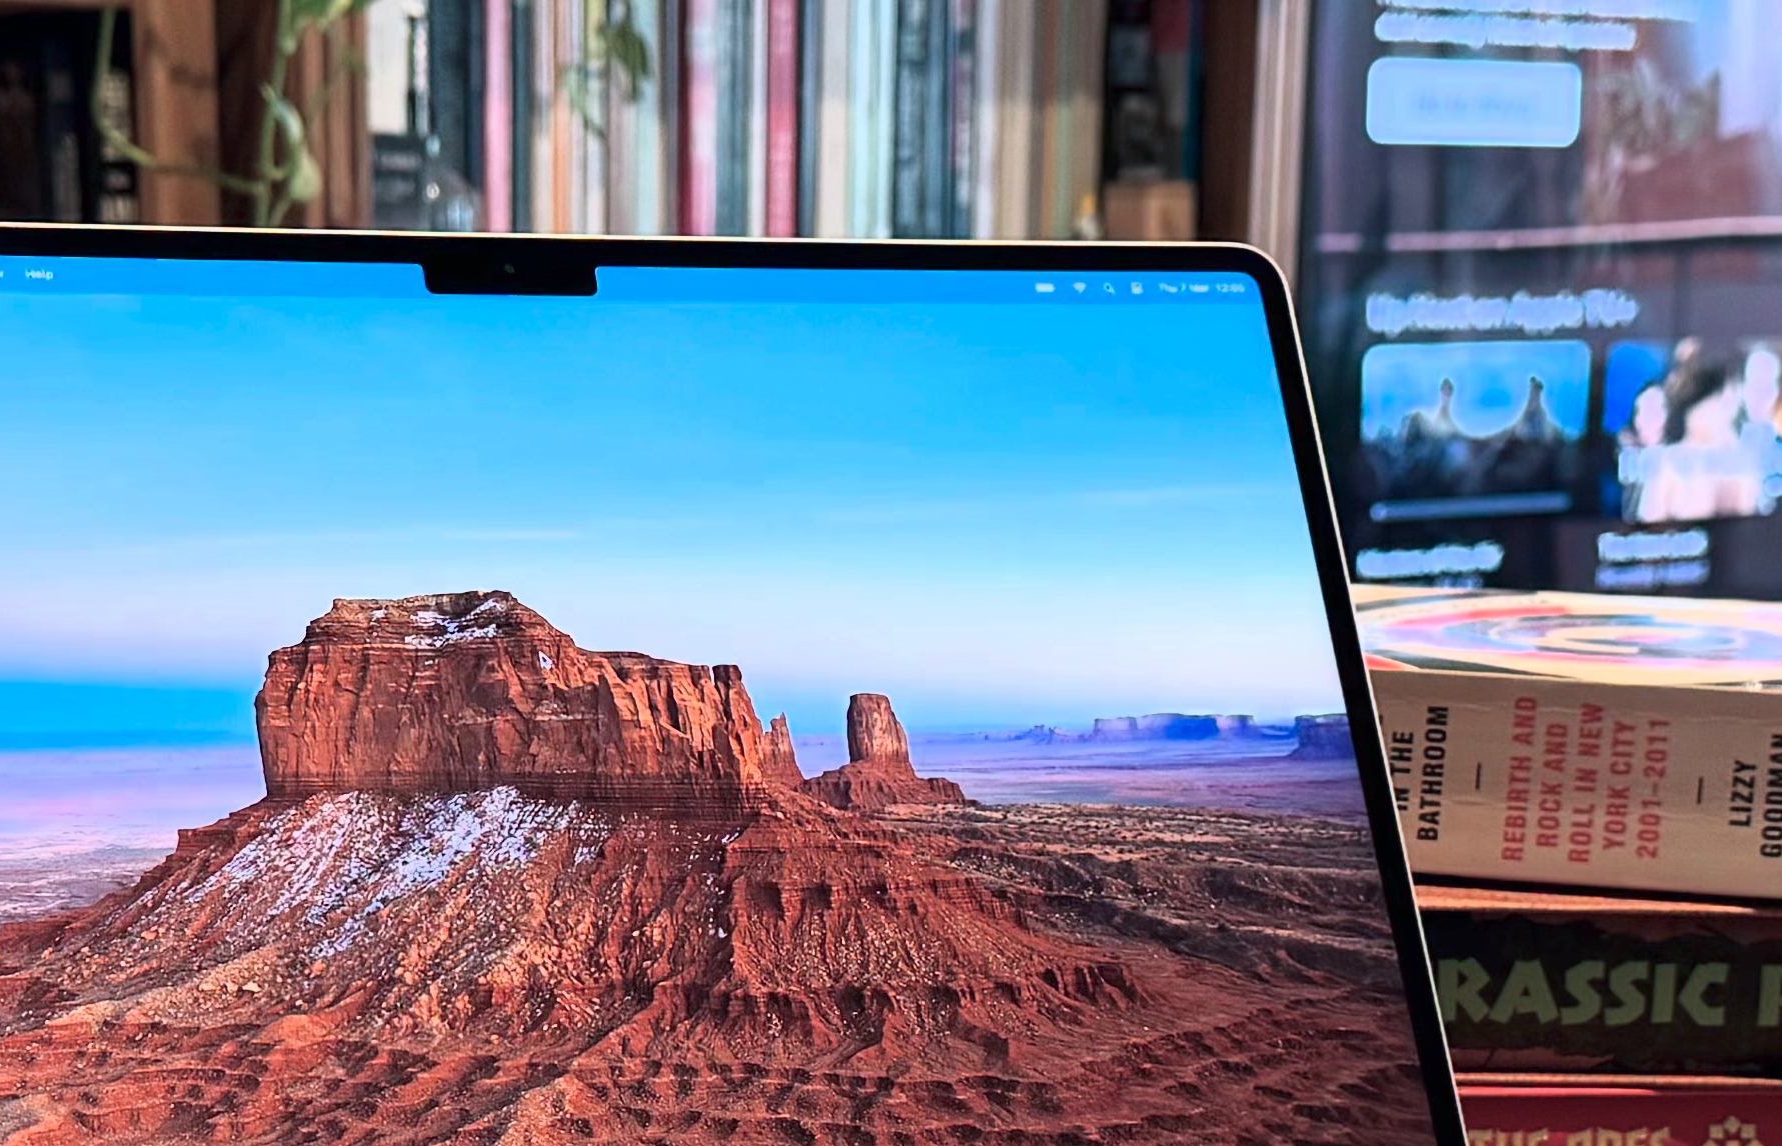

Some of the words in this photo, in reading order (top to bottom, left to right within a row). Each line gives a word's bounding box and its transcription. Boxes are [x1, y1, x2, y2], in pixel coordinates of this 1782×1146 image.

[25, 269, 54, 282] Help
[1513, 697, 1537, 745] AND
[1544, 723, 1567, 772] AND
[1578, 703, 1605, 758] NEW
[1611, 720, 1636, 775] CITY
[1390, 731, 1414, 776] THE
[1417, 706, 1449, 841] BATHROOM
[1575, 768, 1598, 793] IN
[1502, 756, 1532, 862] REBIRTH
[1536, 782, 1564, 848] ROCK
[1603, 786, 1630, 851] YORK
[1729, 760, 1757, 827] LIZZY
[1569, 803, 1595, 863] ROLL
